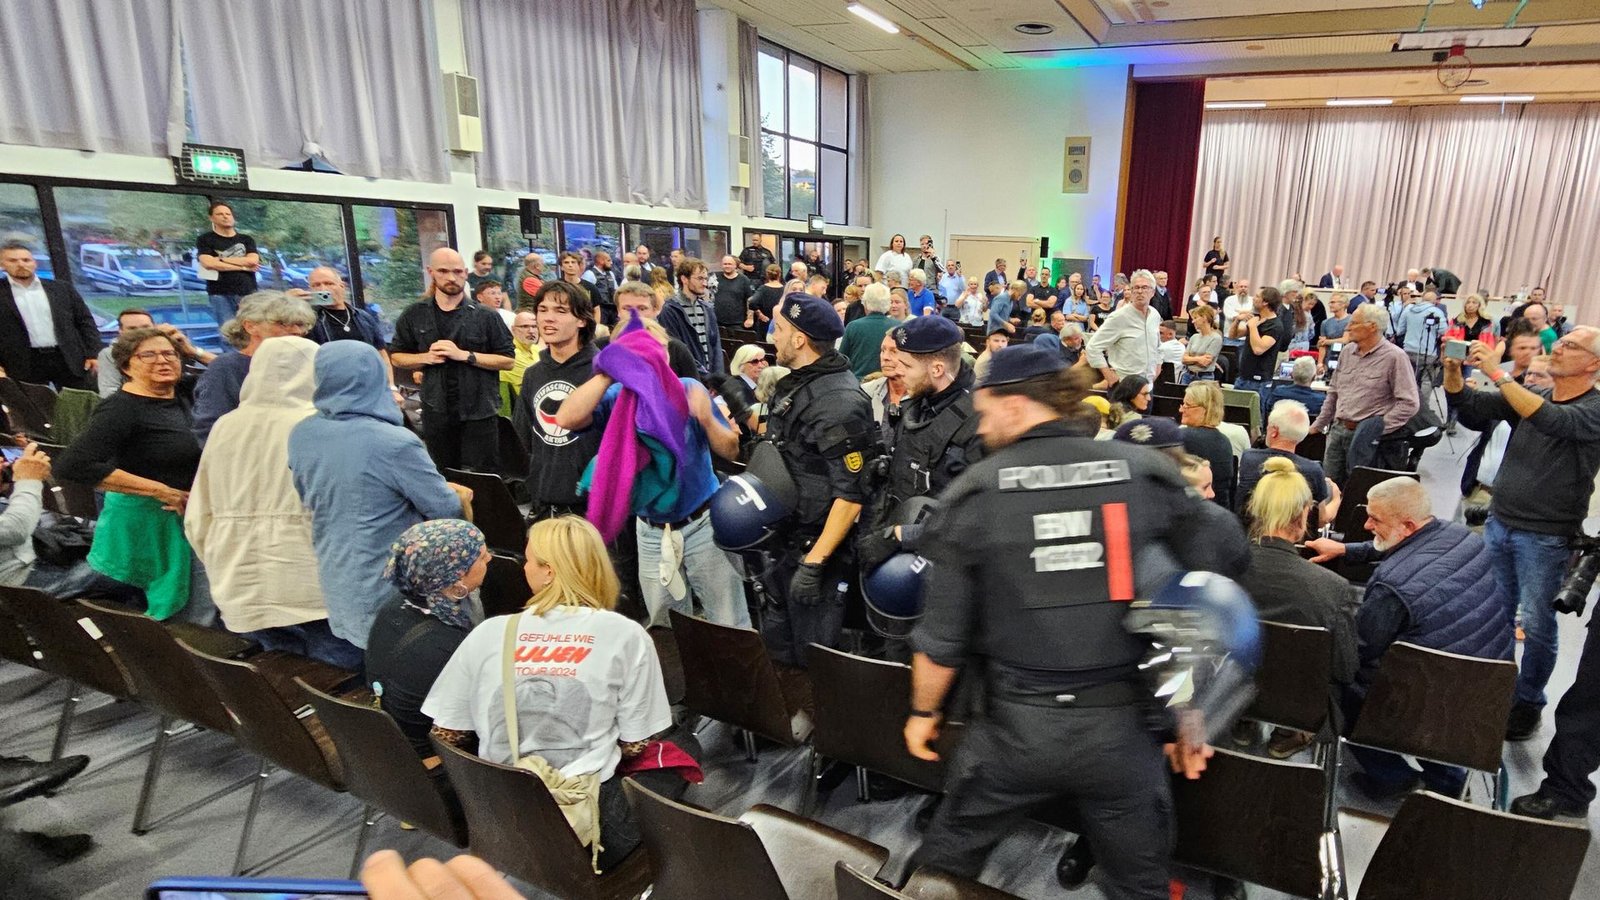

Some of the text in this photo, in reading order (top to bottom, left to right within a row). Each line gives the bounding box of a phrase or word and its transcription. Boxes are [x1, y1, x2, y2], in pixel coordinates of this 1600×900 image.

[999, 459, 1132, 489] POLIZEI
[1033, 510, 1092, 540] BW
[574, 634, 596, 644] WIE
[514, 645, 593, 665] LILIEN
[514, 667, 577, 678] TOUR 2024
